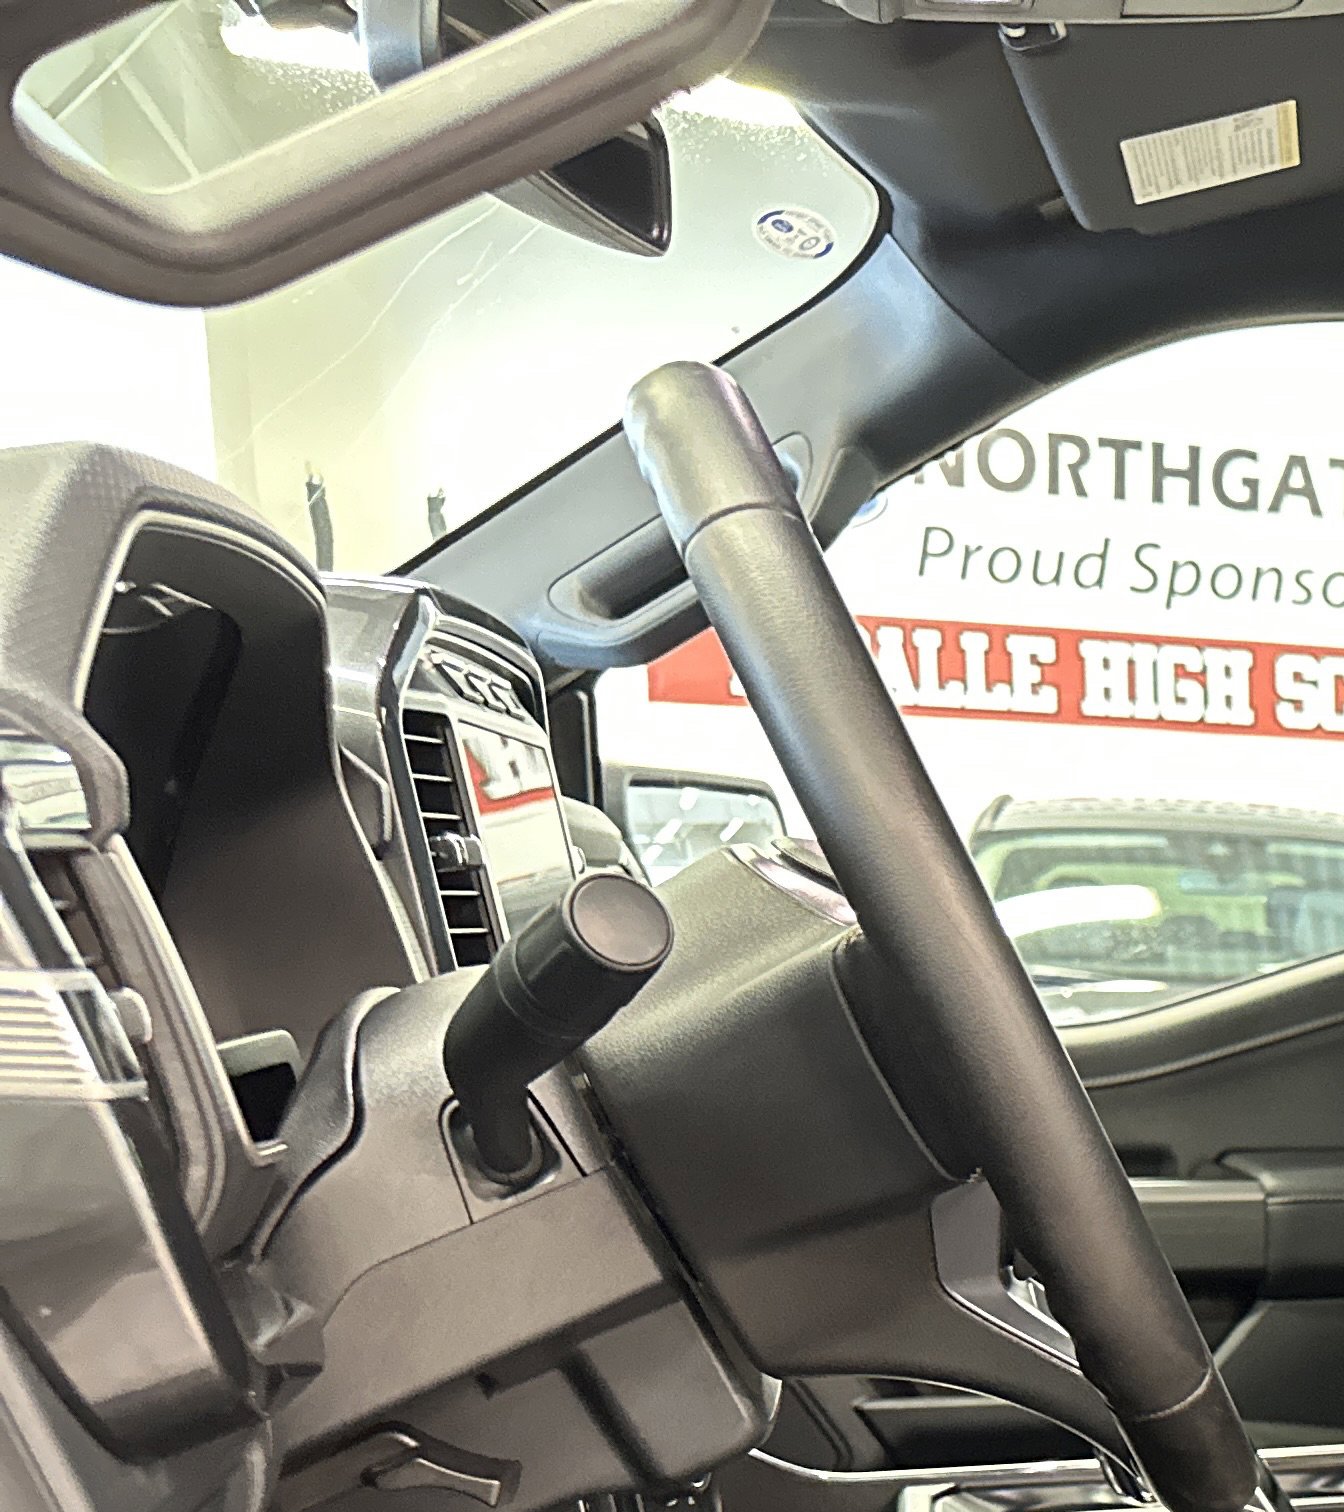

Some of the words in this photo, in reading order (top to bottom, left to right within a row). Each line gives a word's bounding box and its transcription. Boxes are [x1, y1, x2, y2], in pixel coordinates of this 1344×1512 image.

[919, 526, 1110, 592] Proud
[858, 624, 1058, 716] ALLE
[1080, 637, 1255, 727] HIGH
